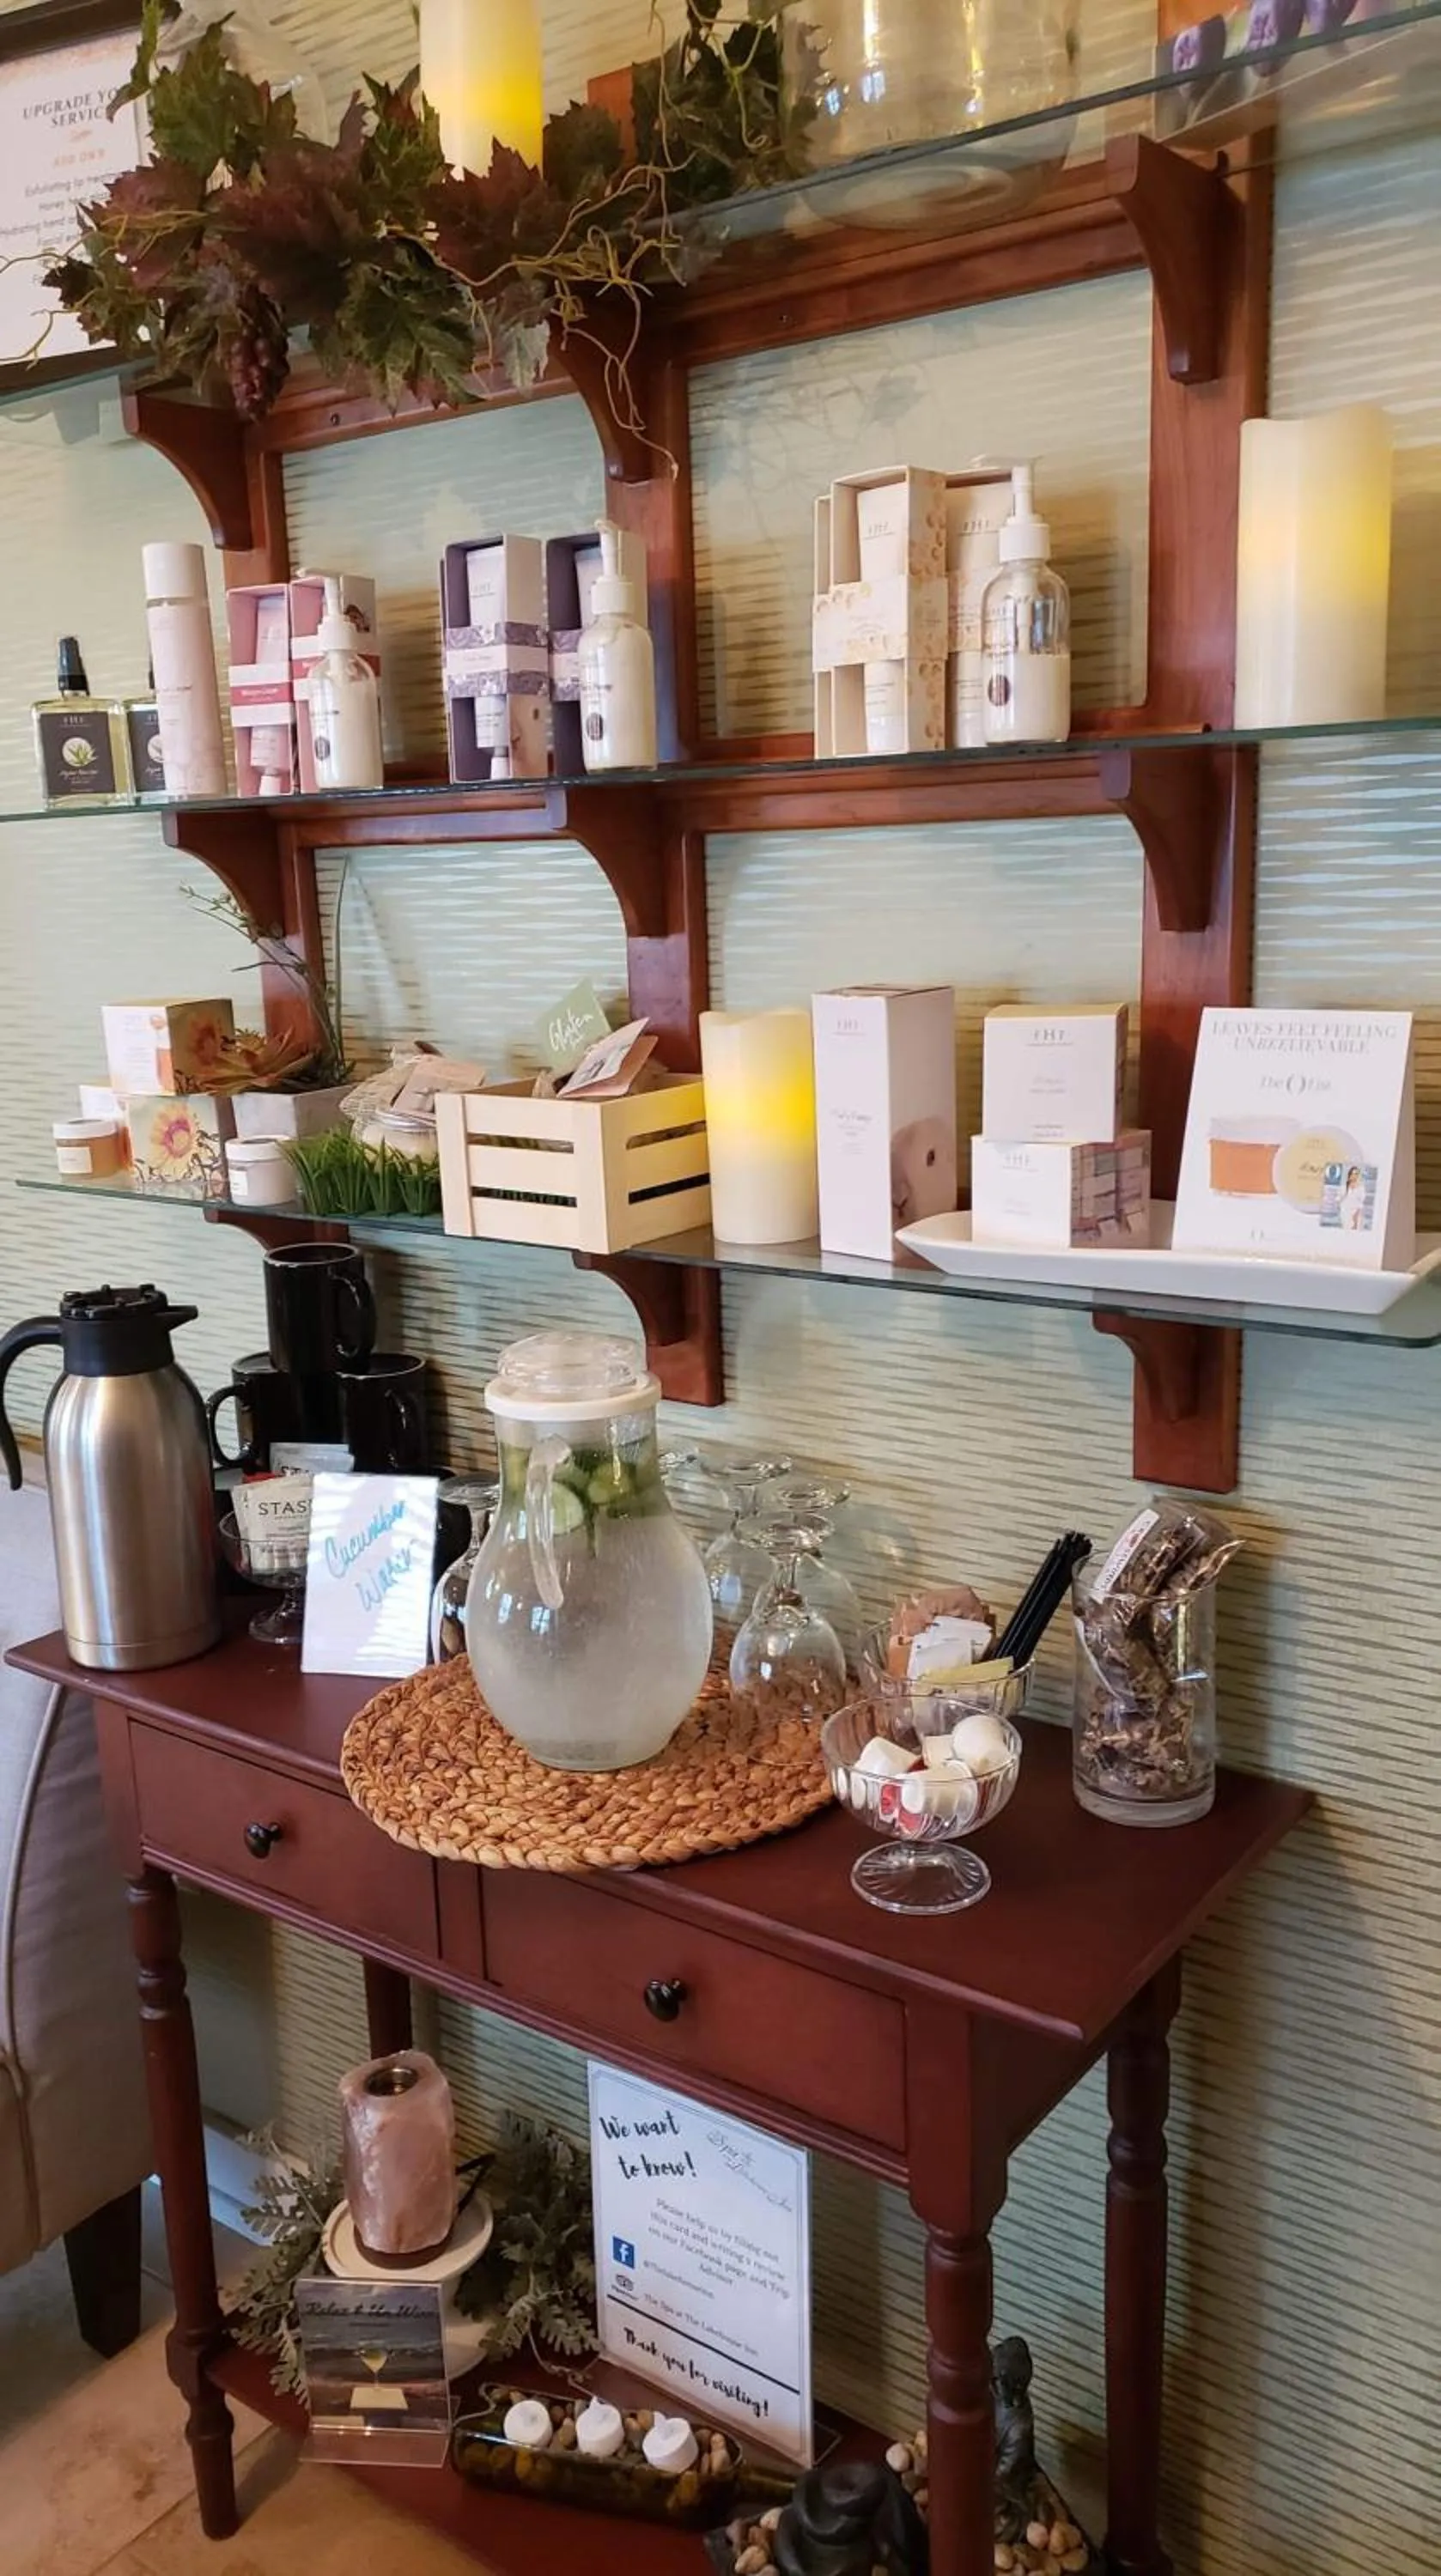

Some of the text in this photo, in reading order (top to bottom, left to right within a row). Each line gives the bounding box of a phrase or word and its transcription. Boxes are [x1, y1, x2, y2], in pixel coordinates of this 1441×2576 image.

[22, 93, 92, 119] UPGRADE
[51, 106, 105, 128] SERVIC
[1212, 1020, 1398, 1039] LEAVES FEET FEELING
[325, 1500, 407, 1579] Cucumber
[599, 2110, 680, 2141] We want
[617, 2154, 640, 2180] to
[641, 2150, 697, 2178] know!
[656, 2197, 684, 2217] Please
[686, 2211, 706, 2230] help
[720, 2228, 733, 2242] by
[669, 2221, 690, 2237] card
[691, 2232, 709, 2245] and
[710, 2241, 745, 2263] writing
[679, 2239, 723, 2267] Facebook
[724, 2263, 747, 2278] page
[749, 2275, 768, 2289] and
[768, 2281, 790, 2300] Trip
[699, 2263, 733, 2285] Advisor
[623, 2327, 769, 2419] Thank you for visiting!
